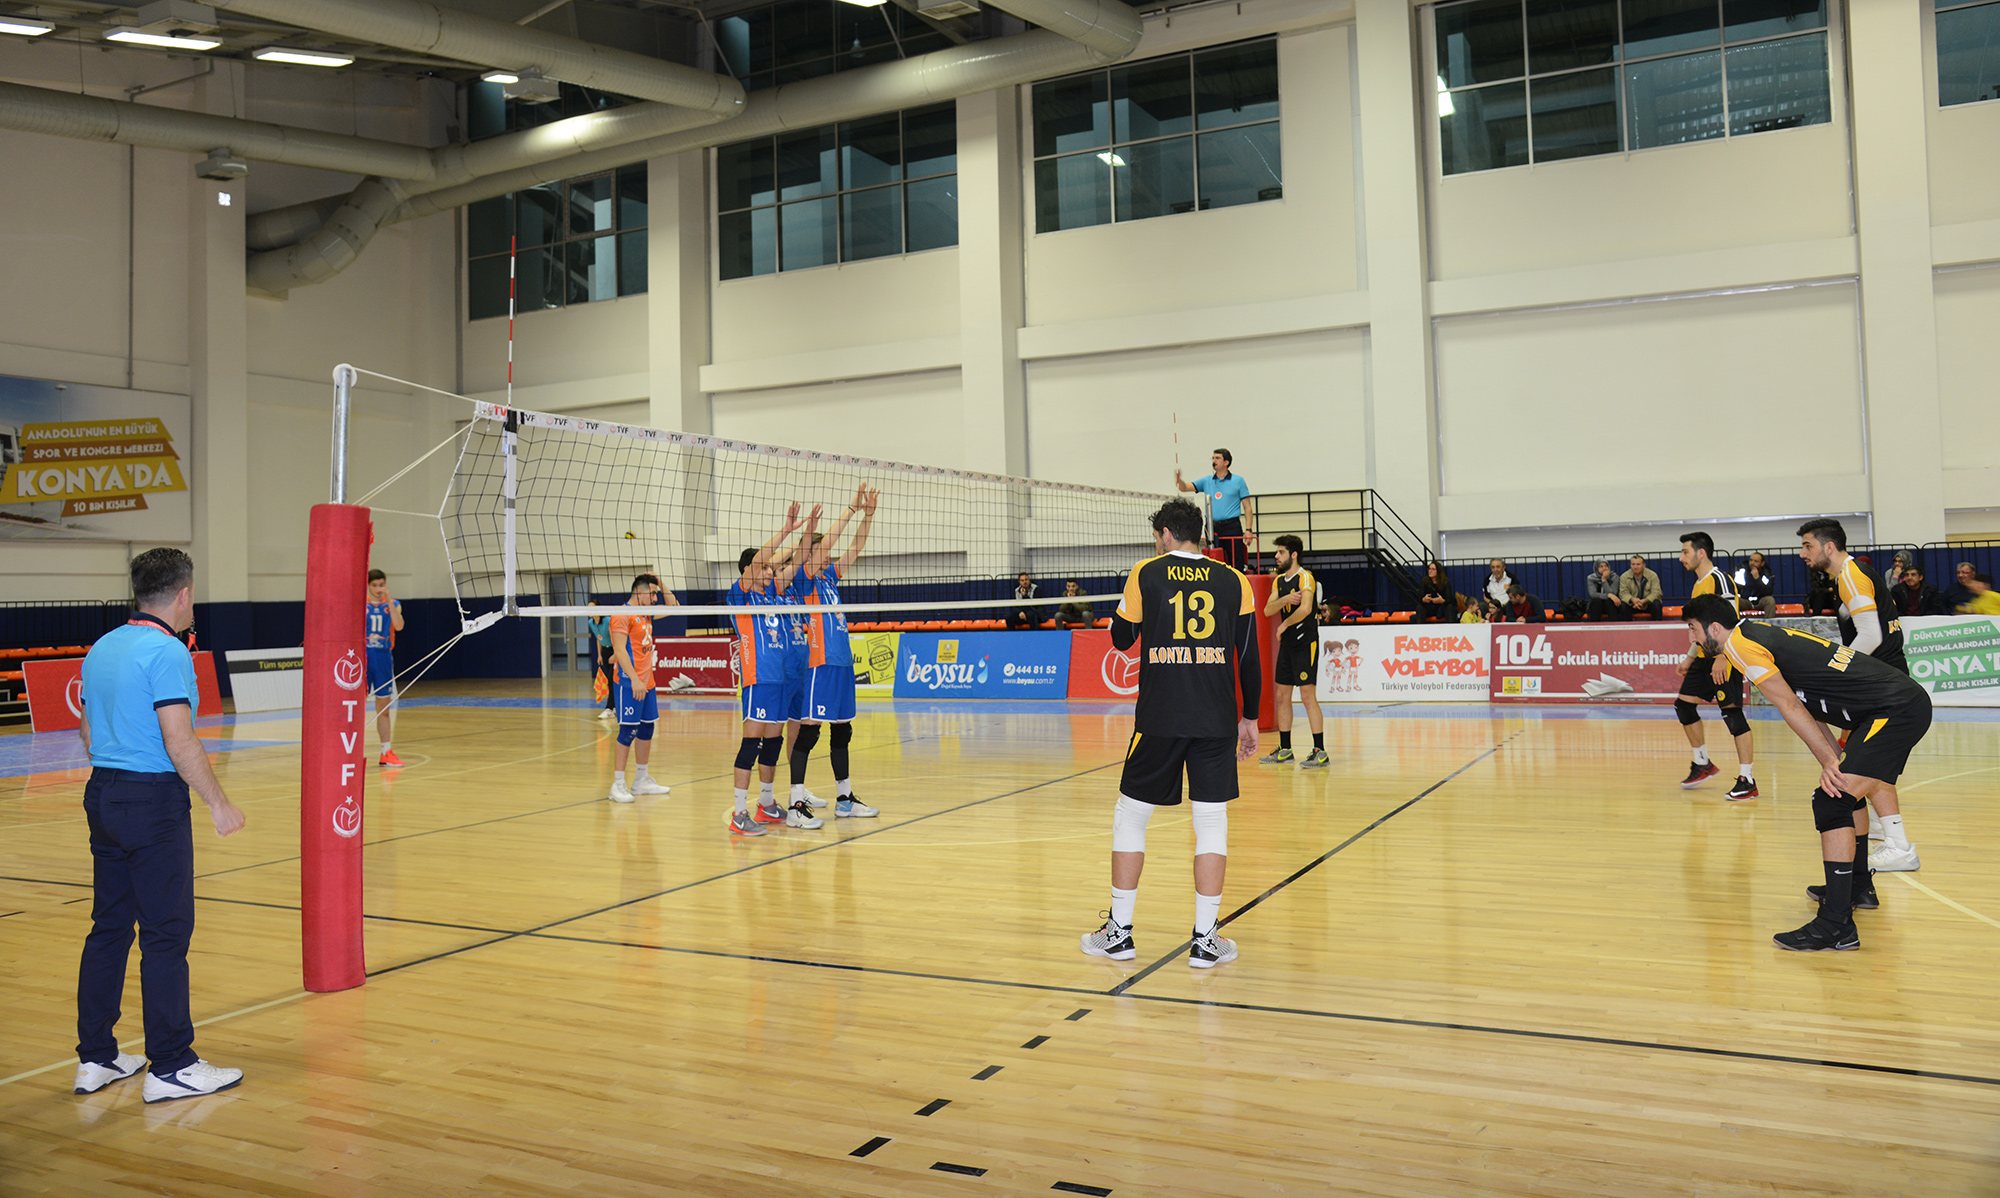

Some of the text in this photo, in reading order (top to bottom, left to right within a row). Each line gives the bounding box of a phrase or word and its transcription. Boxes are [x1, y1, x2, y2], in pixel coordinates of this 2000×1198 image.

[27, 422, 158, 440] ANADOLU'NUN EN BÜYÜK
[494, 405, 507, 417] TV
[554, 417, 568, 426] TVF
[586, 422, 600, 430] TVF
[617, 426, 628, 434] TVF
[645, 430, 656, 438] TVF
[671, 434, 682, 442] TVF
[698, 437, 708, 445] TVF
[722, 440, 733, 448] TVF
[746, 443, 757, 451] TVF
[33, 448, 61, 459] SPOR
[64, 447, 78, 457] VE
[80, 445, 122, 456] KONGRE
[17, 461, 173, 497] KONYA'DA
[73, 502, 86, 513] 10
[1167, 566, 1210, 581] KUSAY
[1168, 590, 1216, 639] 13
[370, 614, 383, 632] 11
[1914, 628, 1961, 640] DÜNYA'NIN
[1963, 626, 1976, 635] EN
[1496, 634, 1688, 670] 104 okula kütüphane
[1908, 639, 1990, 654] STADYUMLARINDAN
[1149, 646, 1192, 664] KONYA
[259, 661, 276, 669] Tüm
[659, 656, 681, 668] okula
[682, 656, 727, 671] kütüphane
[1016, 665, 1057, 674] 444 81 52
[1381, 657, 1489, 679] VOLEYBOL
[907, 654, 974, 689] beysu
[1003, 677, 1055, 686] www.beysu.com.tr
[1381, 682, 1408, 692] Türkiye
[1411, 682, 1443, 692] Voleybol
[1941, 681, 1954, 689] 42
[624, 706, 634, 716] 20
[756, 707, 766, 719] 18
[817, 705, 826, 716] 12
[340, 700, 358, 786] TVF
